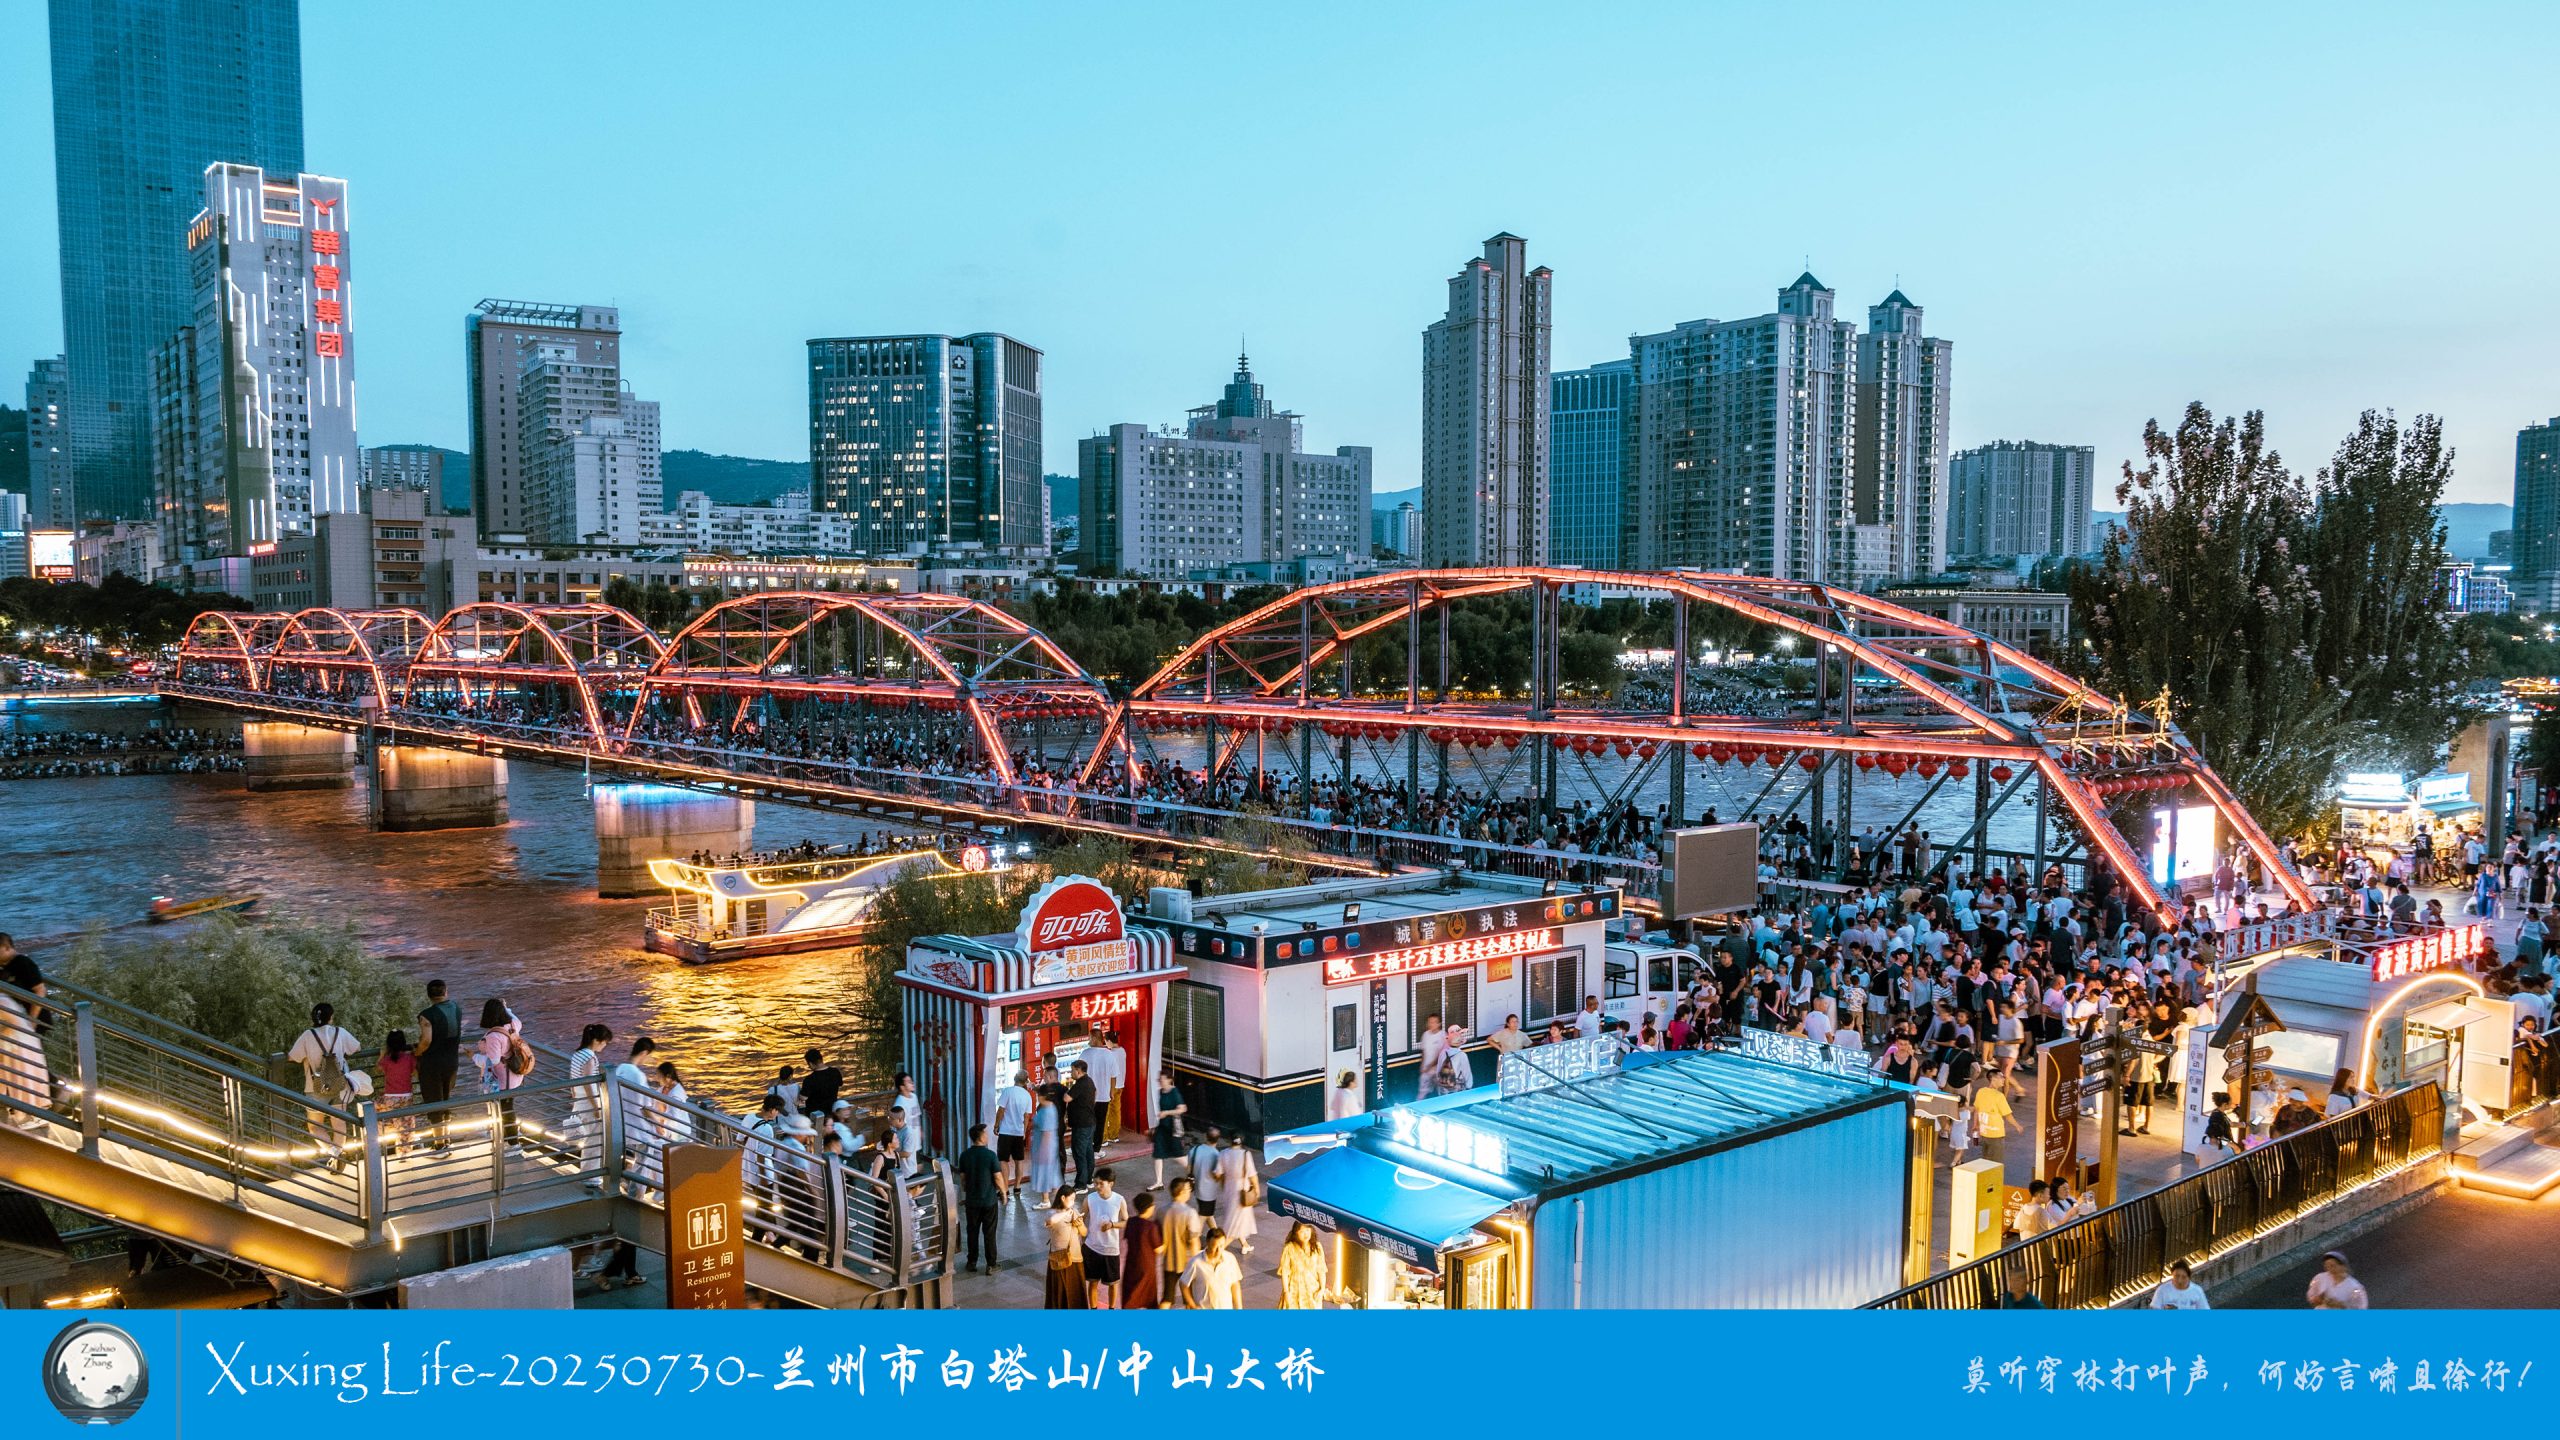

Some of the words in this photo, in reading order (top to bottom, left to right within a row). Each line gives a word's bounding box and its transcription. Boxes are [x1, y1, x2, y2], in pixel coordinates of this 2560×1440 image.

[312, 229, 343, 357] 華富集团
[1040, 907, 1115, 943] 可口可乐
[1395, 921, 1437, 943] 城管
[1480, 911, 1519, 931] 执法
[1066, 942, 1127, 963] 黄河风情线
[1369, 930, 1553, 976] 幸福千万家落实安全规章制度
[2378, 924, 2484, 982] 夜游黄河售票处
[1066, 959, 1127, 978] 大景区欢迎您
[684, 1252, 733, 1275] 卫生间
[686, 1271, 732, 1288] Restrooms
[694, 1287, 724, 1301] トイレ
